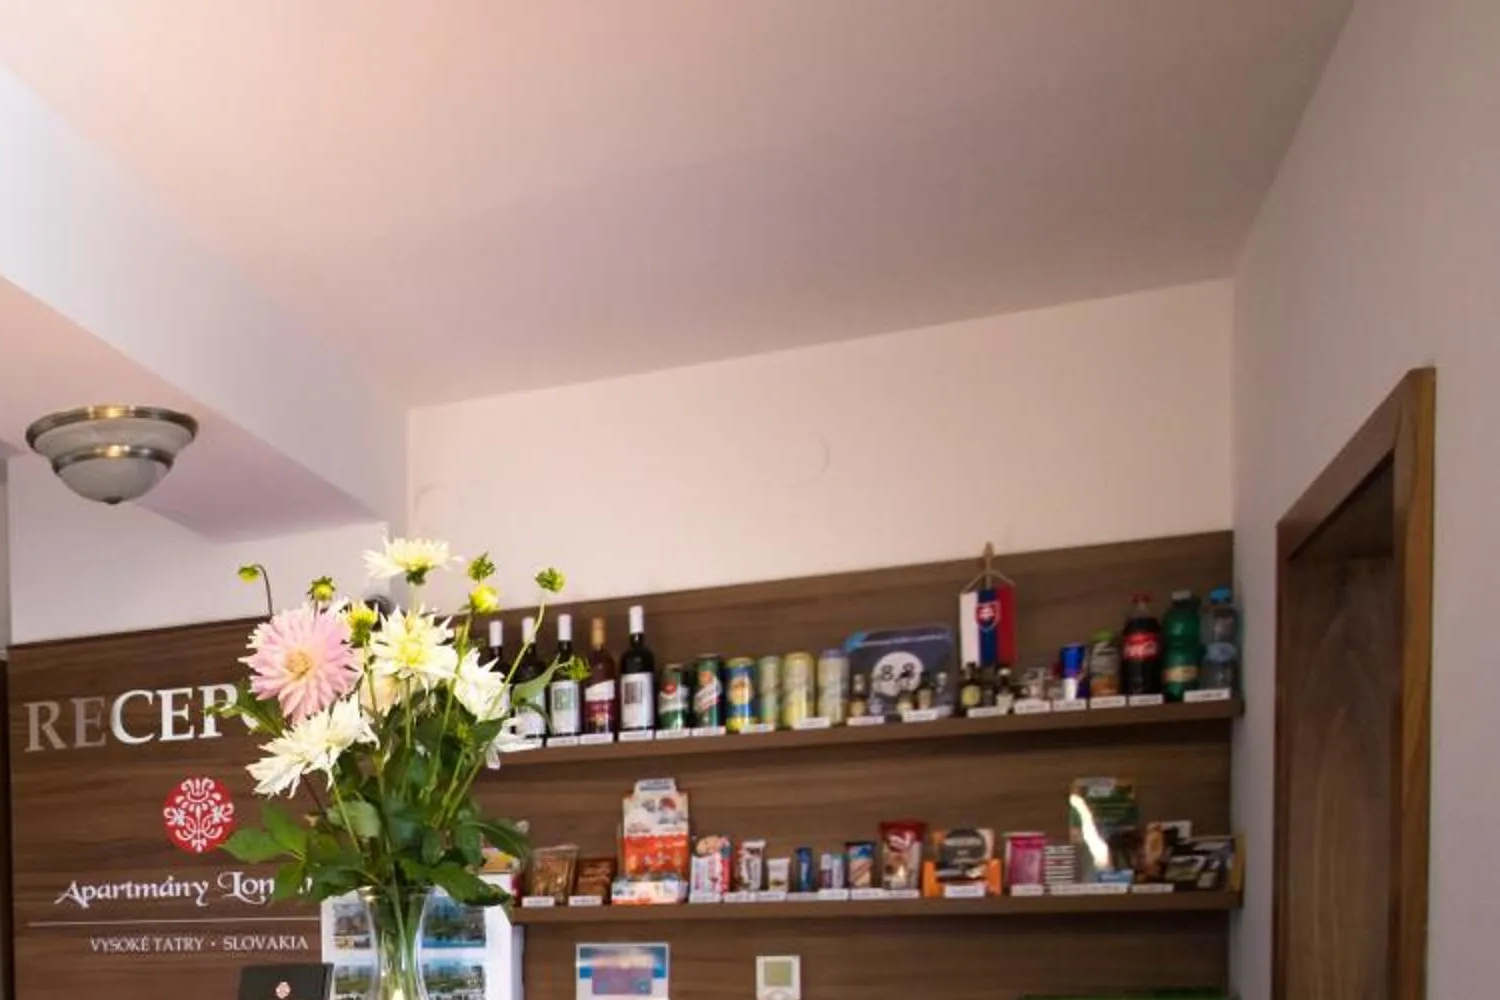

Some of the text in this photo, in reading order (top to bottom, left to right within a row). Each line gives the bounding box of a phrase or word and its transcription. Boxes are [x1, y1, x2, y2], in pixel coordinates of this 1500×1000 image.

[23, 683, 258, 752] RECEP
[54, 874, 209, 908] Apartmány
[90, 935, 309, 952] VYSOKÉ TATRY SLOVAKIA
